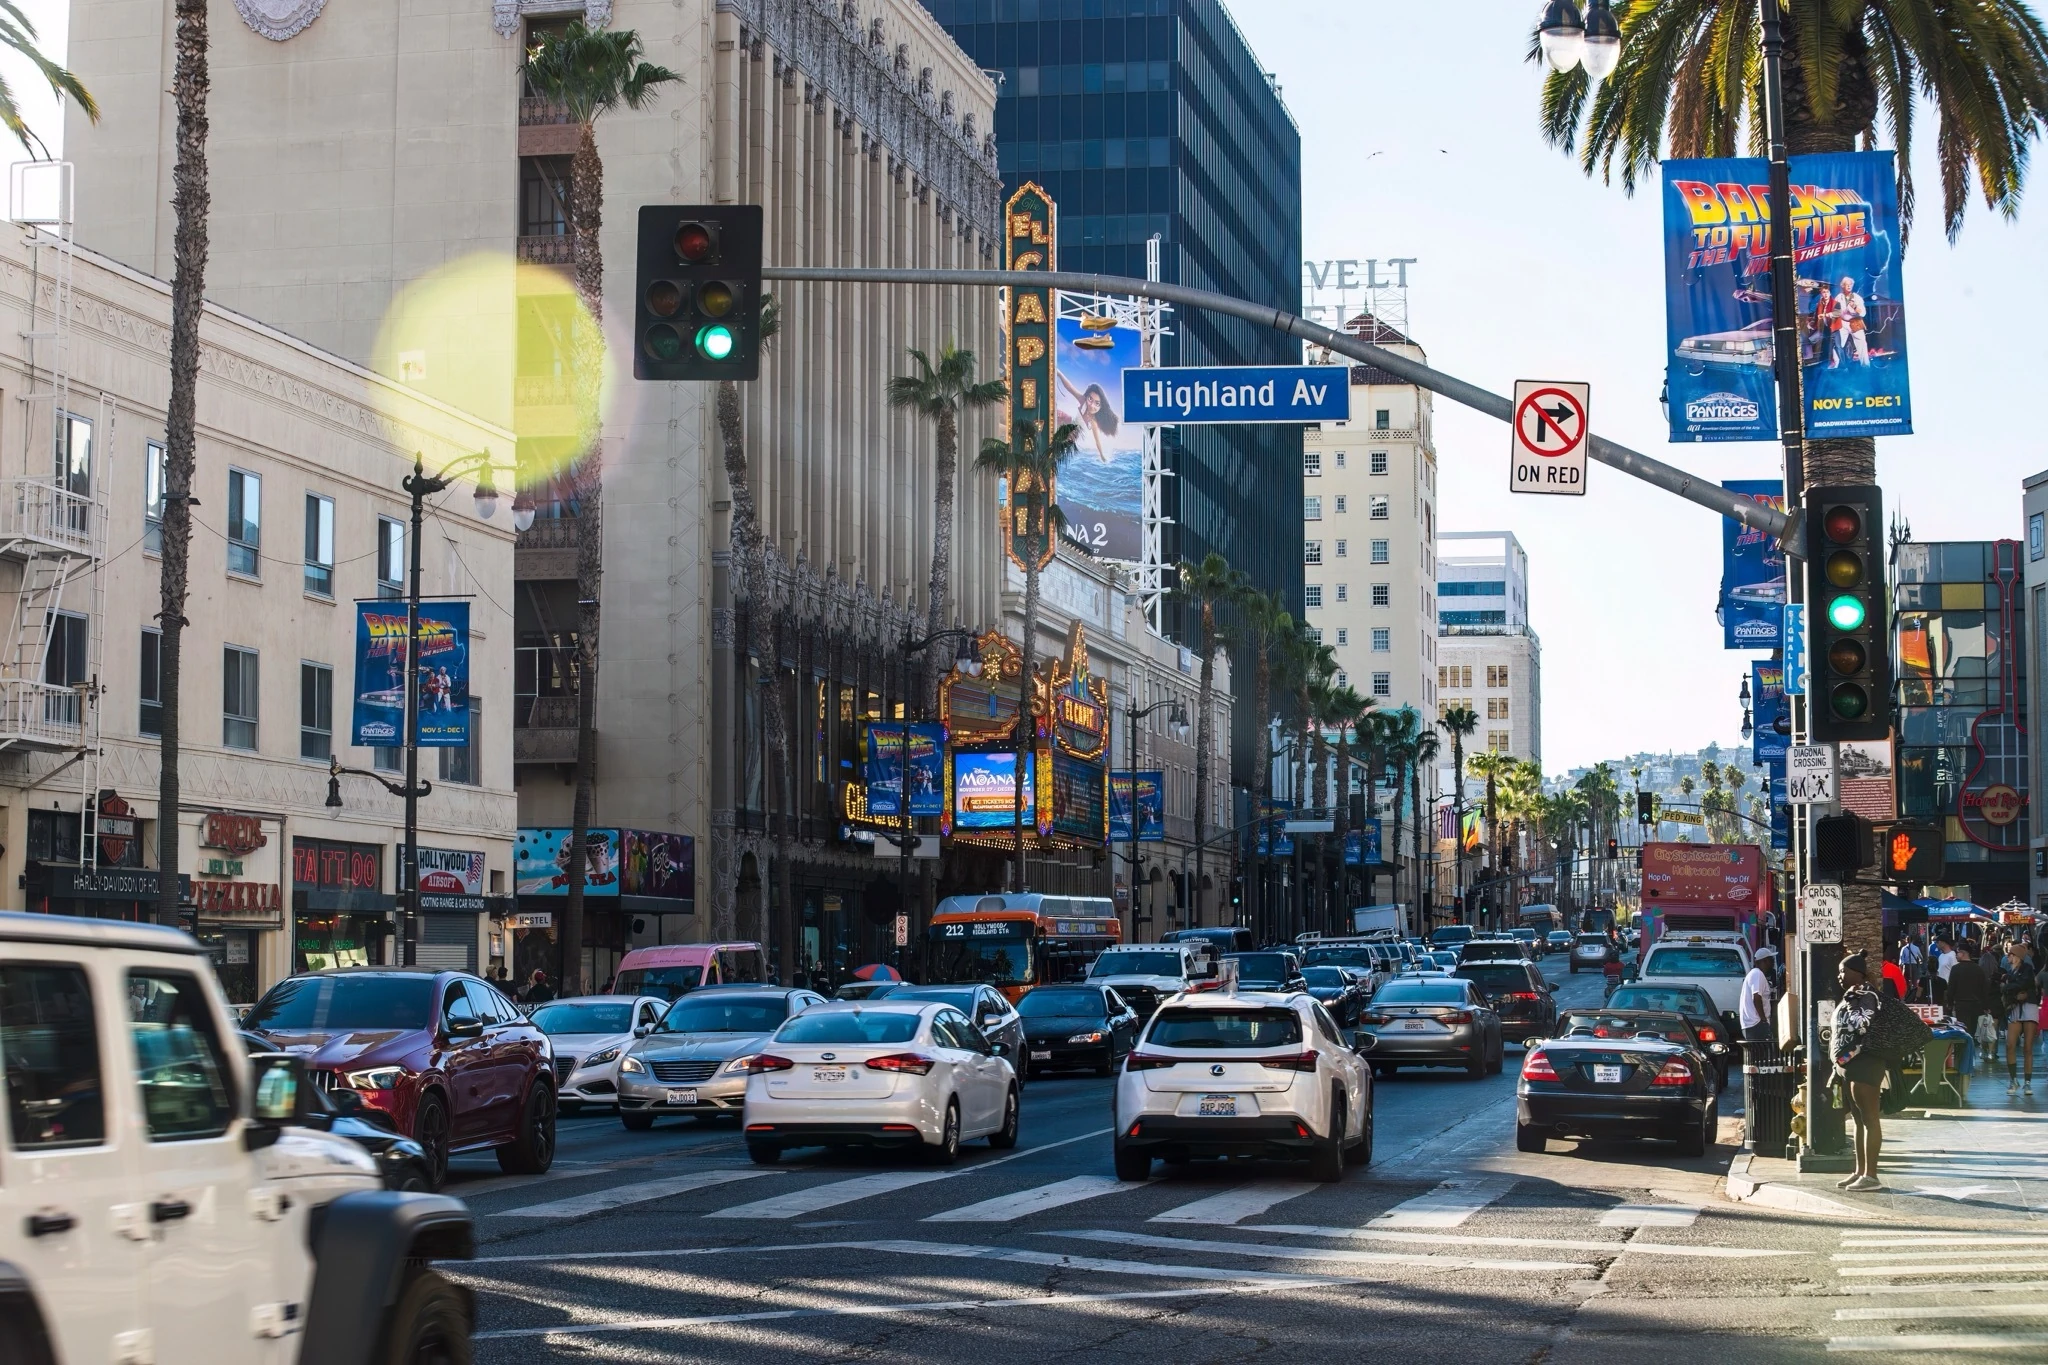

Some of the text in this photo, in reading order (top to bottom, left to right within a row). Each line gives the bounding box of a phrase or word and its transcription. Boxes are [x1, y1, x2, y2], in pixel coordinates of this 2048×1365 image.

[1012, 212, 1049, 245] EL
[1693, 227, 1728, 249] TO
[1800, 237, 1866, 261] THE MUSICAL
[1687, 248, 1727, 270] THE
[1144, 379, 1328, 416] Highland Av
[1813, 398, 1842, 410] NOV
[1845, 398, 1853, 409] 5
[1865, 397, 1892, 408] DEC
[1895, 396, 1901, 406] 1
[1688, 404, 1757, 418] PANTAGES
[1518, 465, 1579, 484] ON RED
[1092, 522, 1109, 547] 2
[1735, 626, 1777, 635] PANTAGES
[432, 647, 454, 655] MUSICAL
[362, 727, 394, 735] PANTAGES
[1793, 747, 1826, 758] DIAGONAL
[1793, 757, 1827, 768] CROSSING
[973, 767, 990, 775] Disney
[960, 772, 1016, 786] MOANA
[1965, 793, 2000, 807] Hard
[1664, 812, 1702, 824] PED XING
[419, 851, 466, 872] HOLLYWOOD
[1654, 848, 1732, 864] CitySightseeing
[209, 859, 243, 876] NEW YORK
[293, 848, 375, 887] TATTOO
[1672, 865, 1720, 877] Hollywood
[73, 874, 137, 892] HARLEY-DAVIDSON
[138, 878, 147, 893] OF
[428, 875, 457, 888] AIRSOFT
[552, 870, 617, 889] BOA TEA
[1648, 873, 1671, 882] Hop On
[1725, 875, 1750, 884] Hop Off
[189, 881, 281, 912] PIZZERIA
[1808, 887, 1836, 897] CROSS
[440, 897, 454, 908] RANGE
[458, 898, 468, 909] CAR
[468, 899, 485, 909] RACING
[1817, 898, 1827, 907] ON
[1811, 907, 1833, 917] WALK
[519, 916, 549, 925] HOSTEL
[946, 925, 964, 937] 212
[517, 1003, 533, 1013] RIVE
[1914, 1007, 1940, 1018] REE
[1201, 1102, 1235, 1112] 8XPJ908
